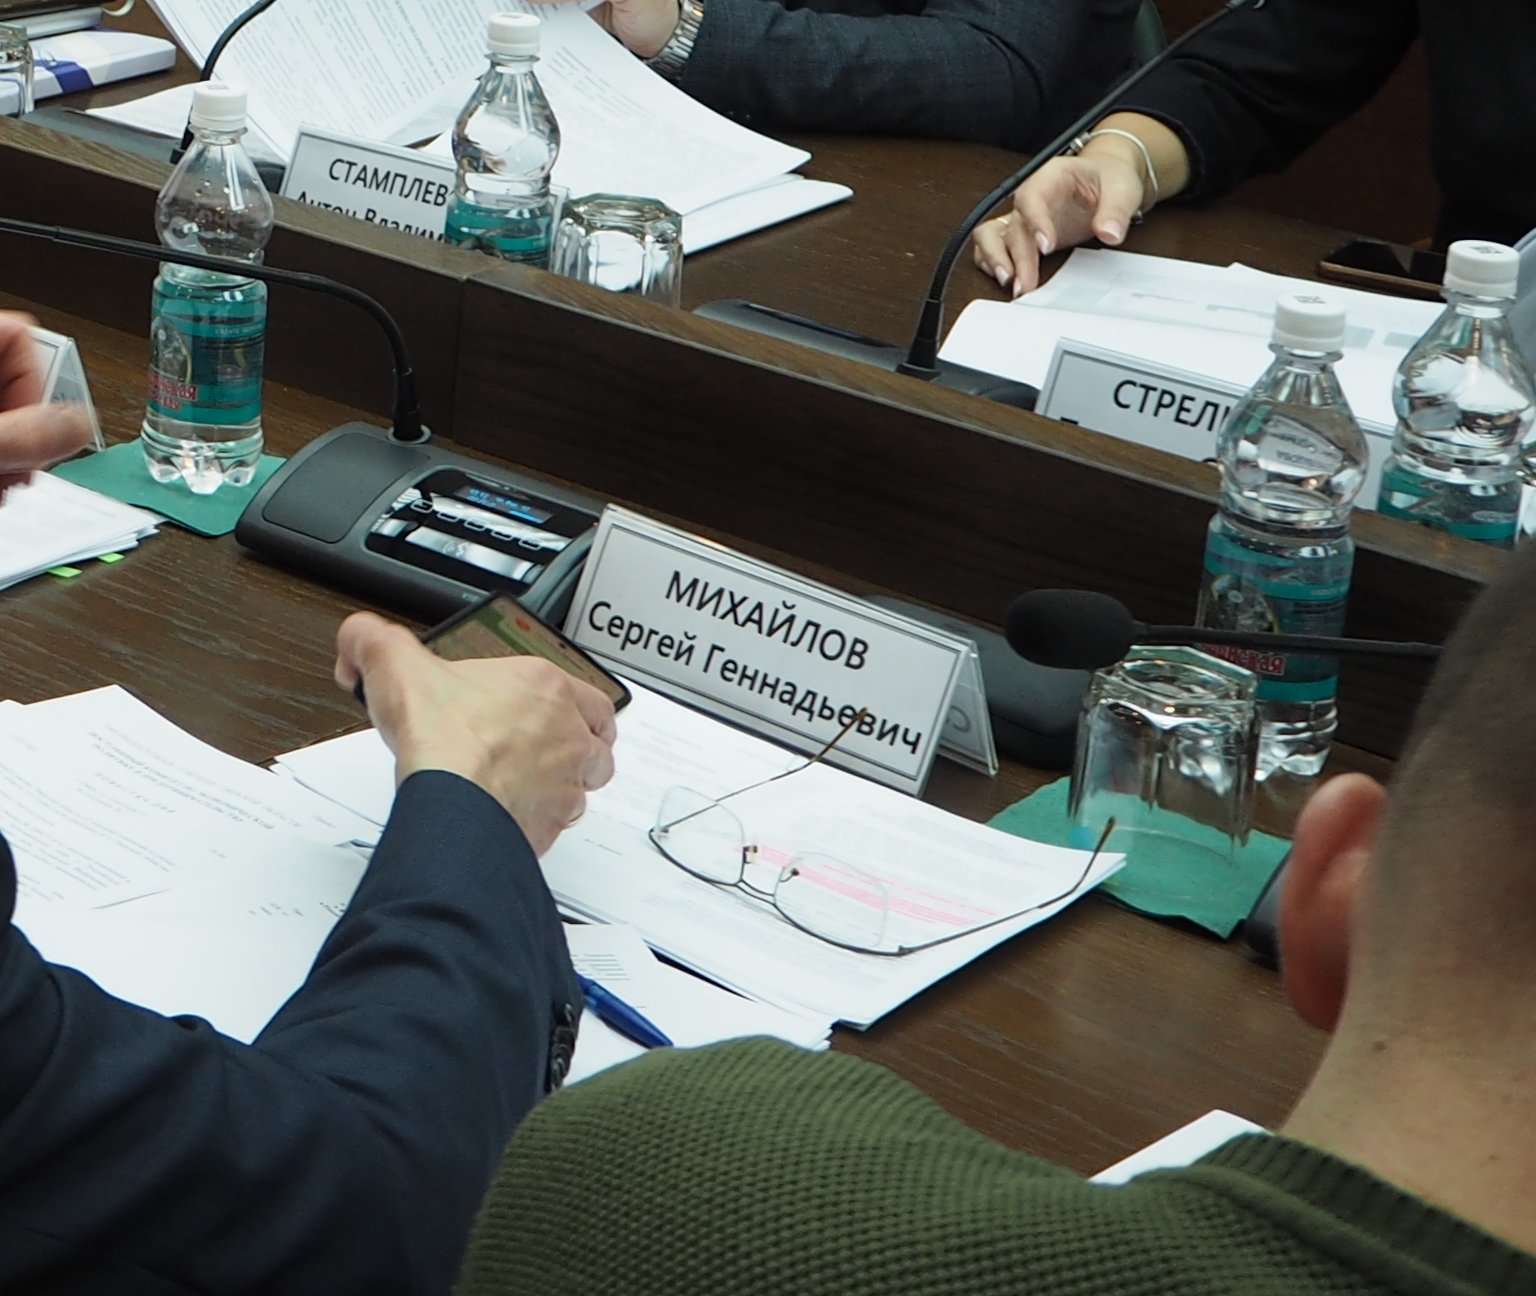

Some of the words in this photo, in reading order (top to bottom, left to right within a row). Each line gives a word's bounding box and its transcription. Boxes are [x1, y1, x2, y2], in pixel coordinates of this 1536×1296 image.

[328, 157, 454, 207] СТАМПЛЕВ
[665, 570, 870, 671] МИХАЙЛОВ
[588, 600, 697, 667] Сергей
[702, 643, 923, 755] Геннадьевич
